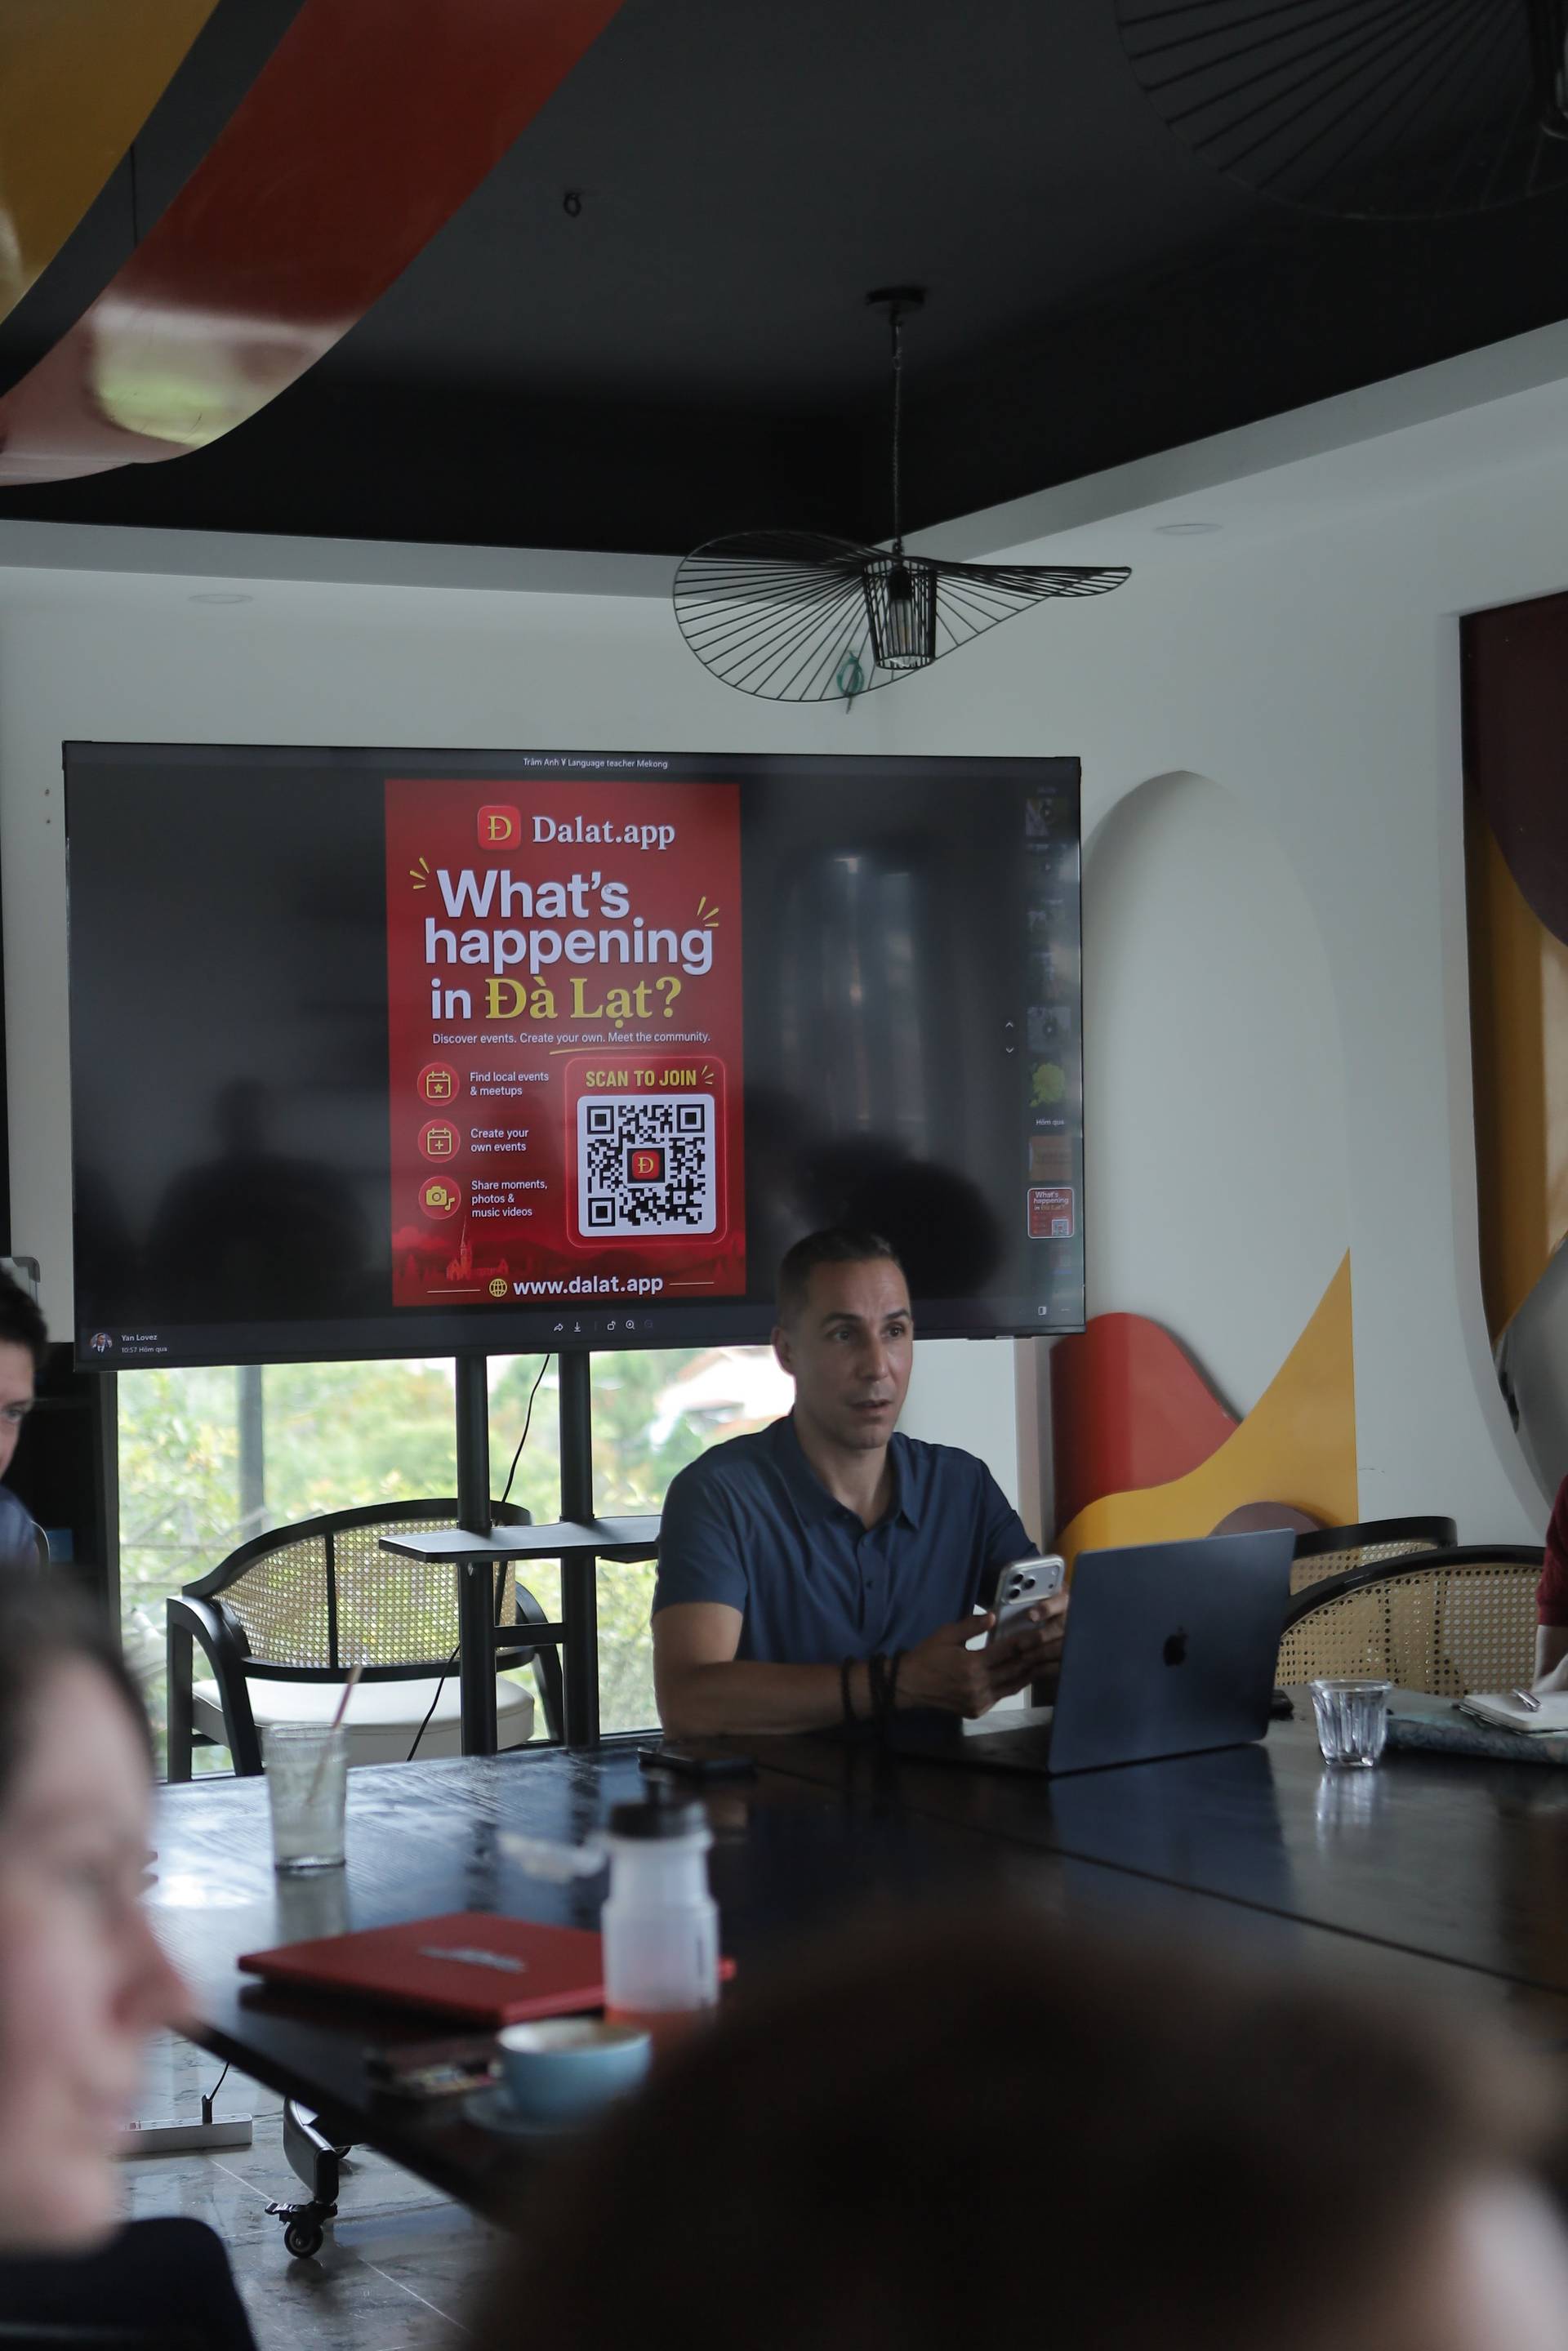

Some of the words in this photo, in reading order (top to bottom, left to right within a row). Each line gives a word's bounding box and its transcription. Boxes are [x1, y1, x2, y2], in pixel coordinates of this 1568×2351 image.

[568, 759, 604, 769] Language
[637, 760, 667, 769] Mekong
[532, 816, 675, 850] Dalat.app
[437, 870, 630, 919] What’s
[425, 917, 713, 975] happening
[431, 978, 471, 1020] in
[485, 976, 557, 1019] Đà
[569, 977, 682, 1028] Lạt?
[433, 1032, 477, 1044] Discover
[480, 1033, 517, 1044] events.
[519, 1032, 554, 1044] Create
[556, 1034, 578, 1045] your
[581, 1034, 605, 1043] own.
[608, 1032, 633, 1042] Meet
[635, 1032, 652, 1042] the
[654, 1032, 710, 1044] community.
[470, 1072, 491, 1082] Find
[493, 1071, 515, 1082] local
[518, 1072, 549, 1082] events
[586, 1071, 628, 1087] SCAN
[635, 1071, 655, 1087] TO
[659, 1070, 697, 1086] JOIN
[470, 1086, 477, 1096] &
[479, 1086, 523, 1098] meetups
[470, 1129, 505, 1139] Create
[507, 1129, 528, 1141] your
[470, 1143, 490, 1152] own
[492, 1142, 527, 1152] events
[471, 1180, 499, 1191] Share
[501, 1180, 547, 1191] moments,
[471, 1194, 505, 1205] photos
[507, 1194, 514, 1204] &
[472, 1207, 500, 1218] music
[502, 1207, 532, 1217] videos
[513, 1276, 663, 1295] www.dalat.app
